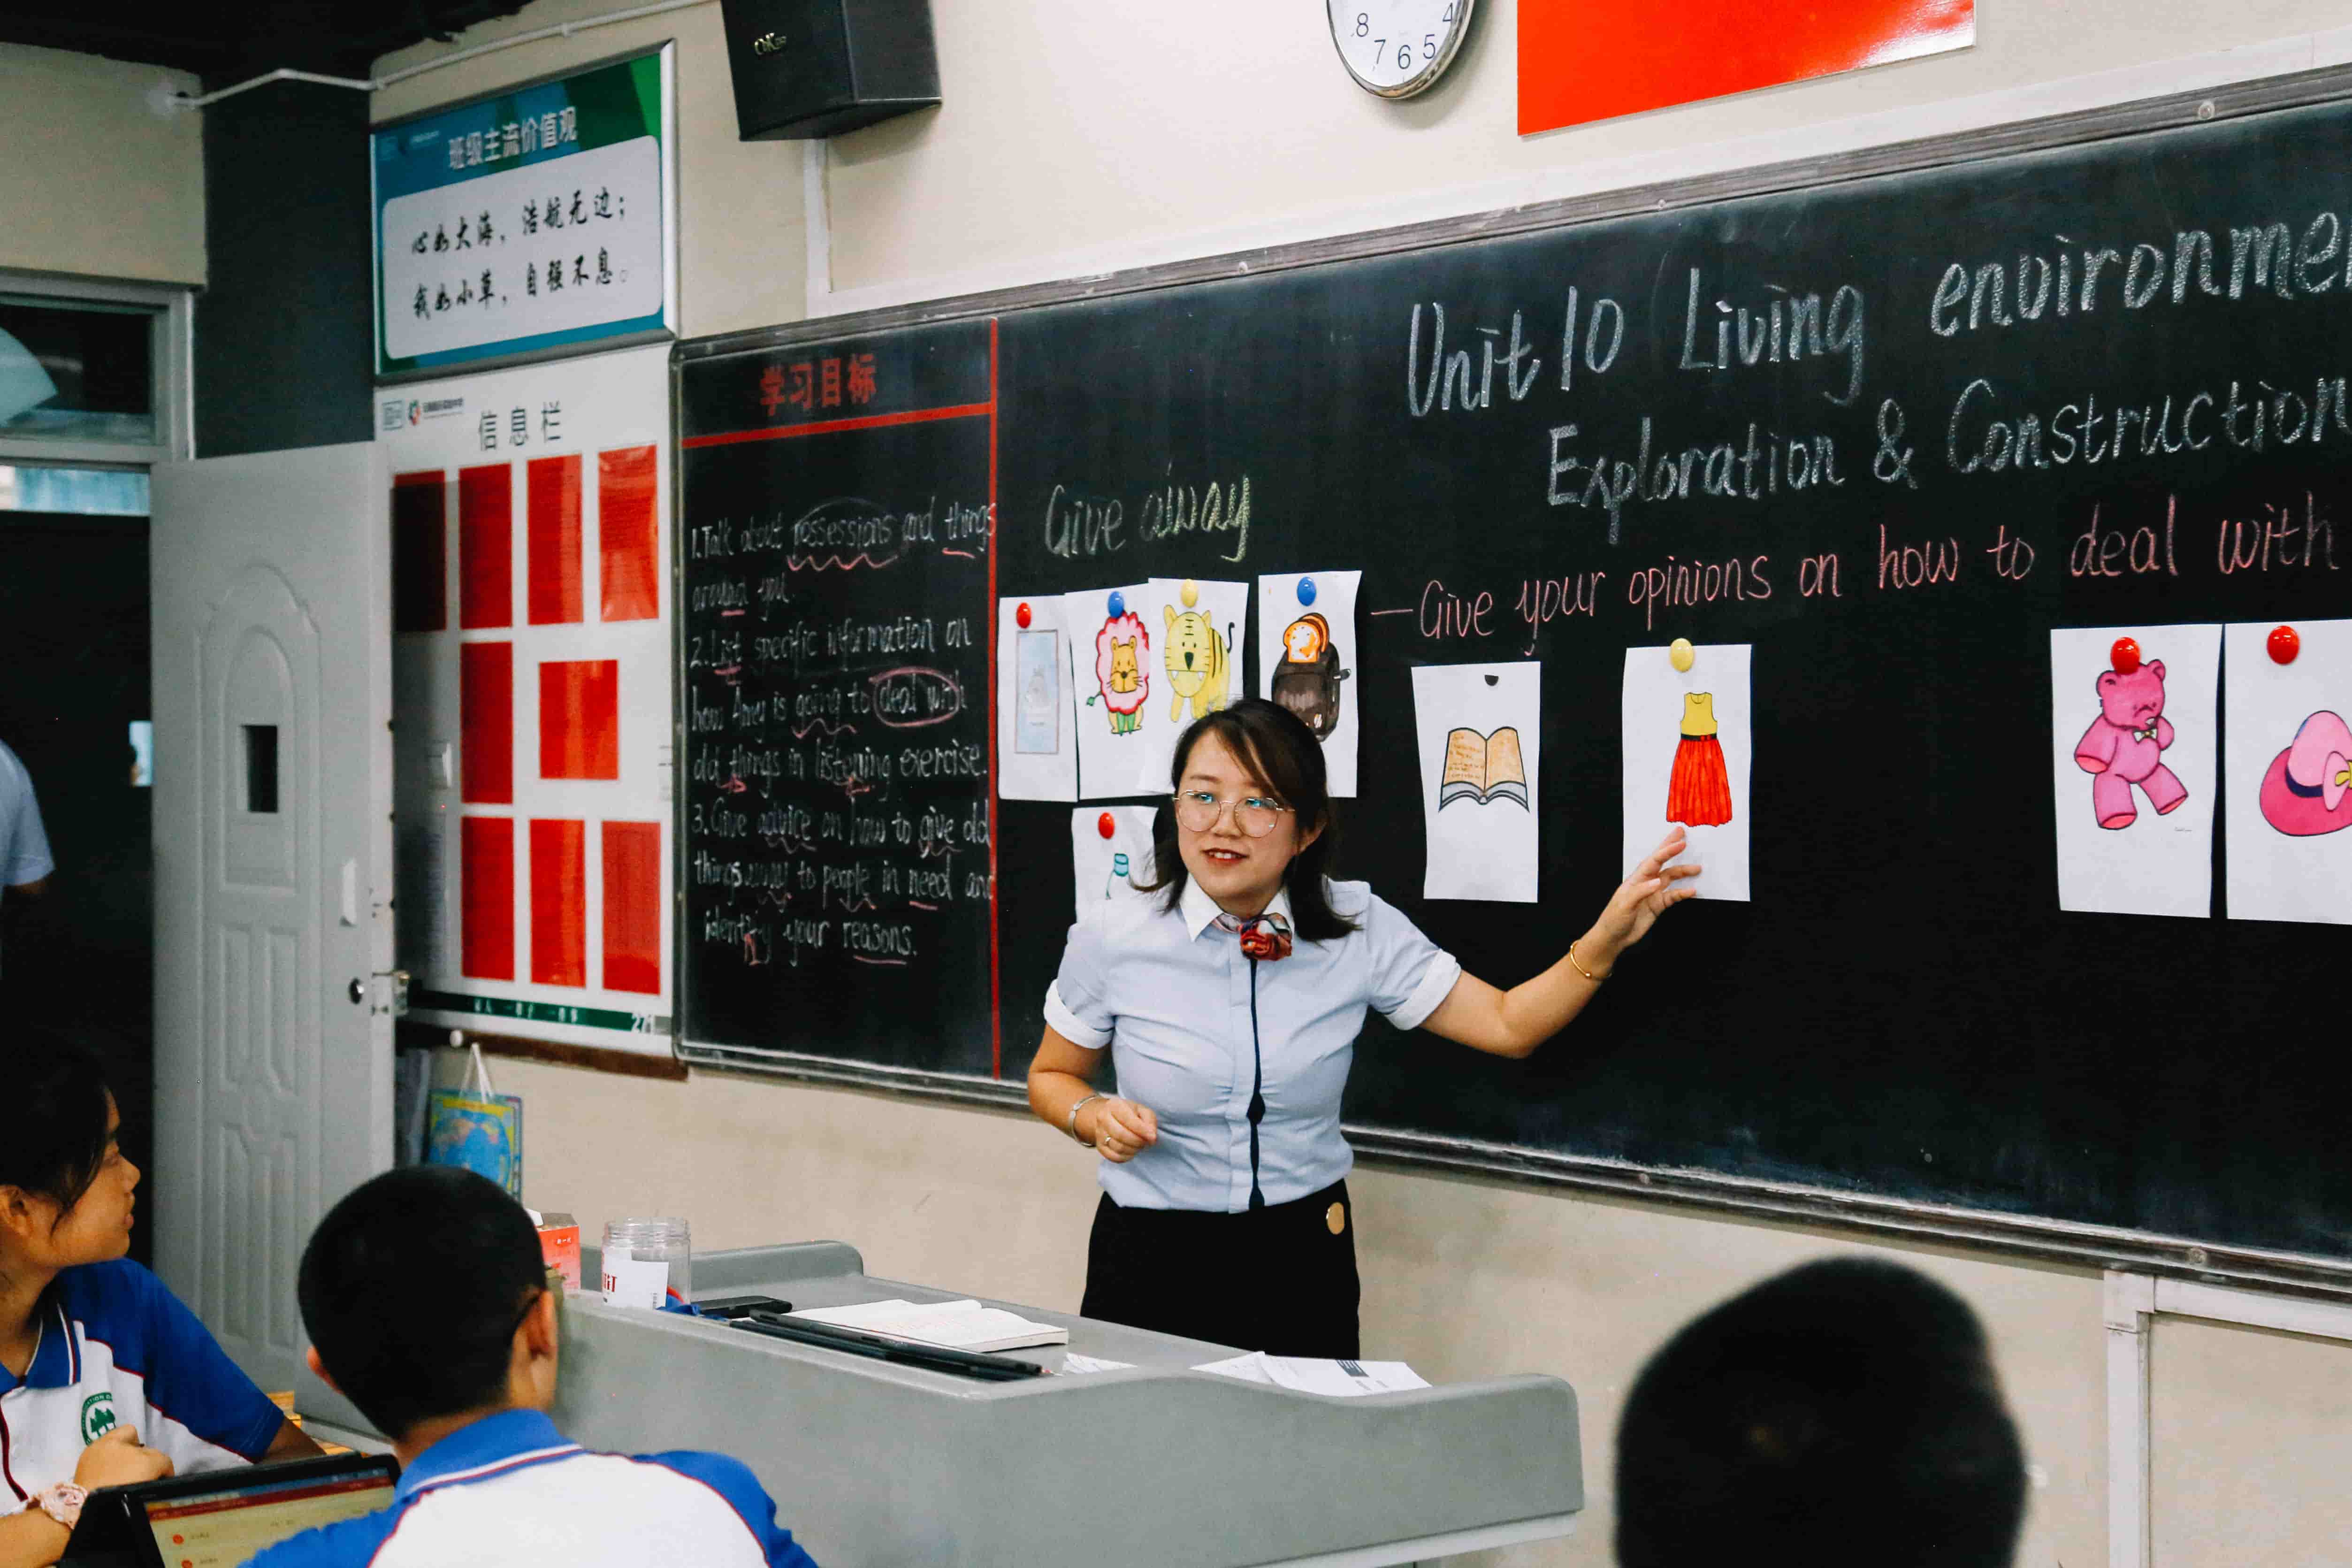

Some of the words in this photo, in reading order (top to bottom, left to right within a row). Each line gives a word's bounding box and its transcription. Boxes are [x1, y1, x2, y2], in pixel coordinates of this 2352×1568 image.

[1356, 13, 1369, 37] 8
[1442, 2, 1453, 22] 4
[1374, 39, 1386, 64] 7
[1397, 45, 1411, 69] 6
[1423, 34, 1436, 59] 5
[449, 106, 577, 170] 班级主流价值观
[1407, 301, 1541, 417] Unit
[1560, 285, 1624, 391] 10
[1679, 267, 1864, 406] Living
[1930, 211, 2352, 337] environme
[760, 353, 877, 416] 学习目标
[479, 400, 562, 451] 信息栏
[1548, 416, 1846, 545] Exploration
[1873, 398, 1918, 490] &
[1947, 376, 2352, 474] Construction
[741, 512, 783, 552] about
[902, 495, 935, 543] and
[1044, 484, 1127, 558] Give
[1138, 474, 1250, 563] away
[1515, 571, 1606, 656] your
[1629, 555, 1772, 631] opinions
[1800, 553, 1843, 598] on
[1878, 523, 1959, 590] how
[1986, 525, 2036, 581] to
[2070, 493, 2178, 577] deal
[2218, 490, 2341, 575] with
[772, 690, 787, 722] is
[847, 682, 871, 714] to
[891, 811, 912, 845] to
[797, 859, 817, 890] to
[882, 859, 901, 895] in
[908, 852, 954, 901] need
